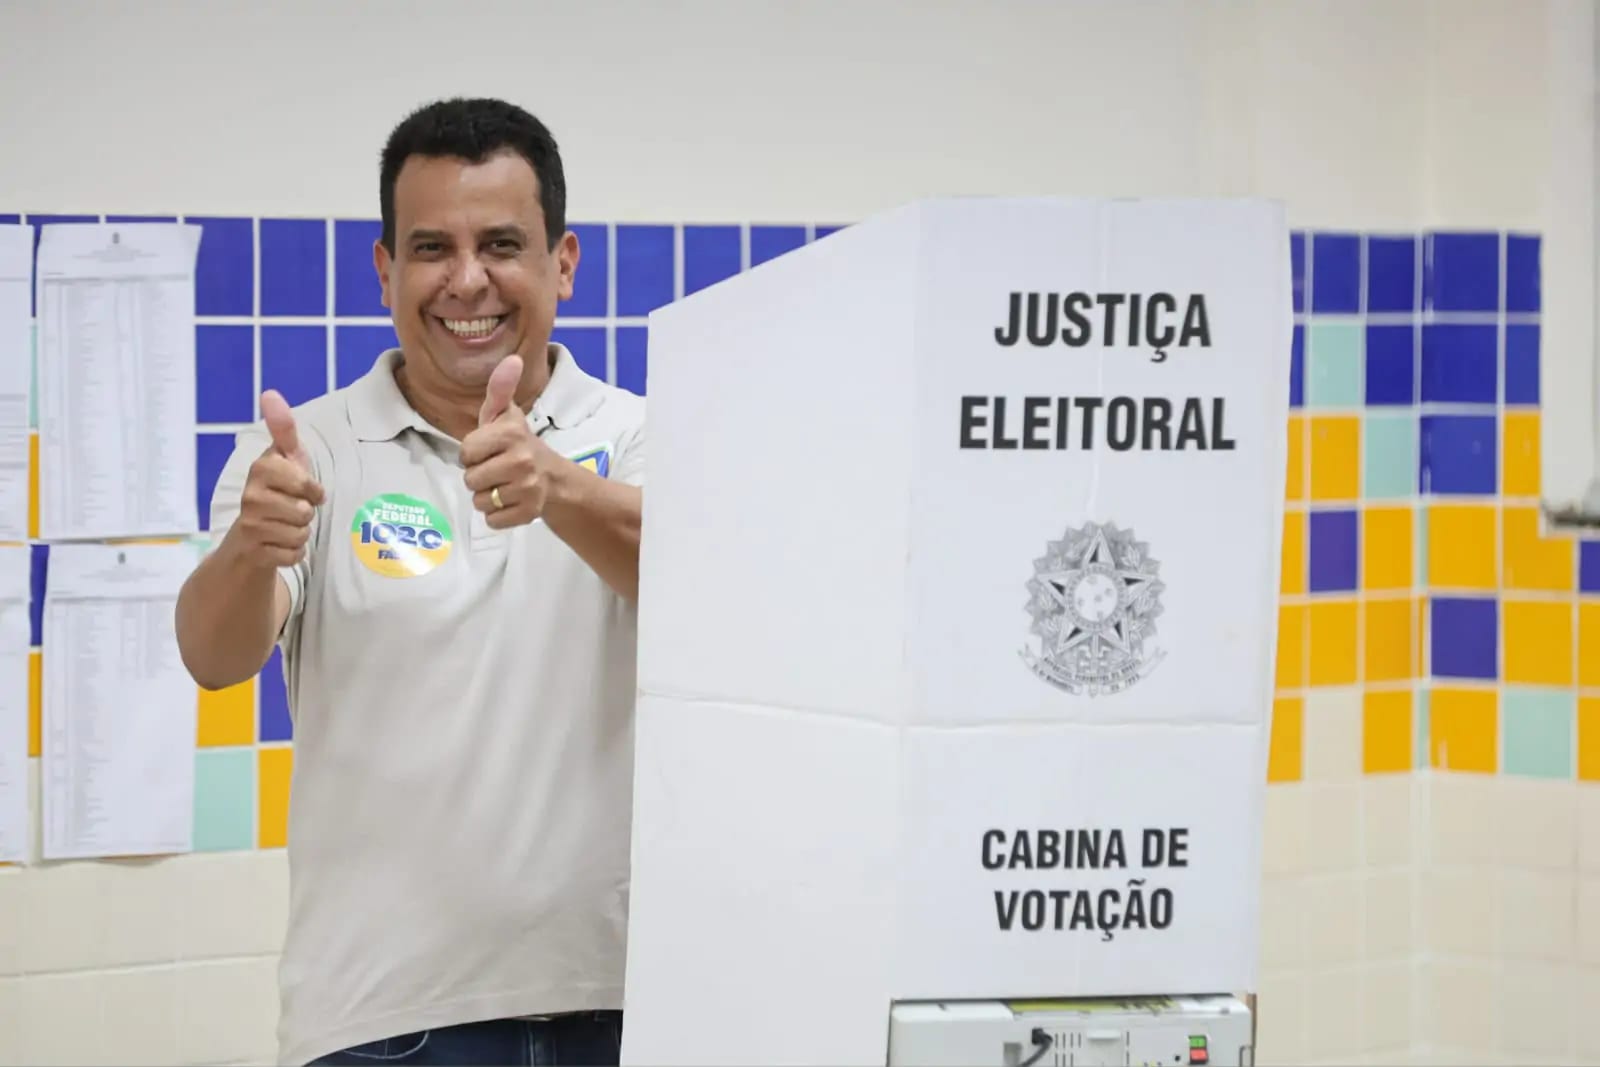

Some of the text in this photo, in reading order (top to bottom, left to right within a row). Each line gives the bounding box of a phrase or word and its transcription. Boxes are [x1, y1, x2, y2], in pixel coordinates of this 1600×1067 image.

[994, 291, 1212, 363] JUSTIÇA
[959, 395, 1236, 451] ELEITORAL
[360, 520, 443, 550] 1020
[373, 508, 434, 527] FEDERAL
[981, 827, 1189, 870] CABINA DE
[994, 878, 1174, 942] VOTAÇÃO
